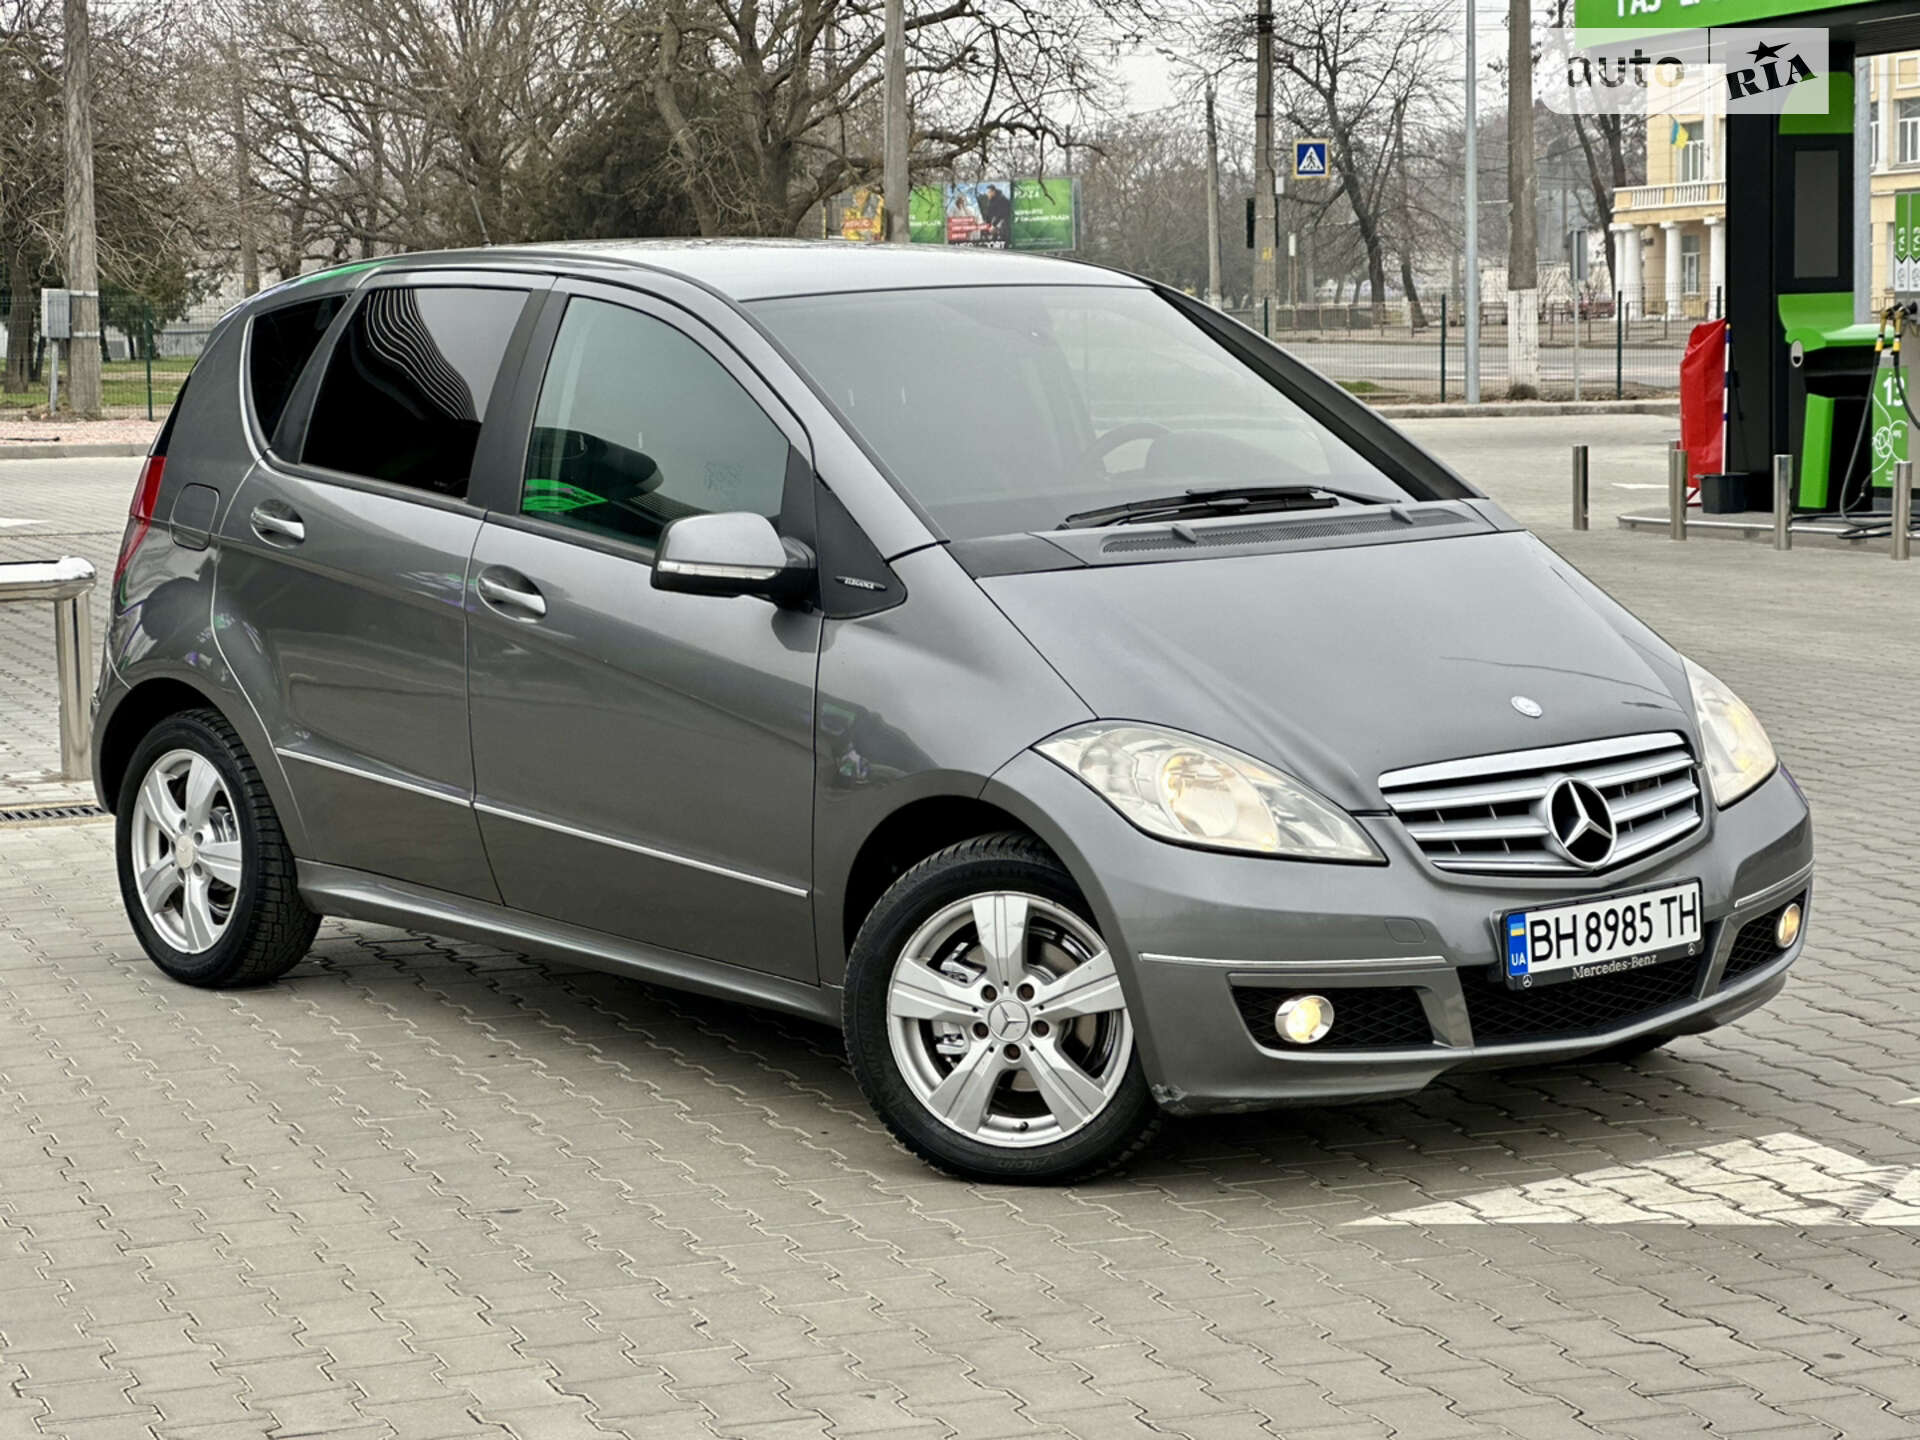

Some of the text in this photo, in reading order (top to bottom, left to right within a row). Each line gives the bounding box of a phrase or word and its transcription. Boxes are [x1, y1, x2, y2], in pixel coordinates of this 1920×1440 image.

[1530, 891, 1697, 963] BH 8985 TH
[1511, 952, 1527, 967] UA
[1572, 953, 1657, 980] Mercedes-Benz
